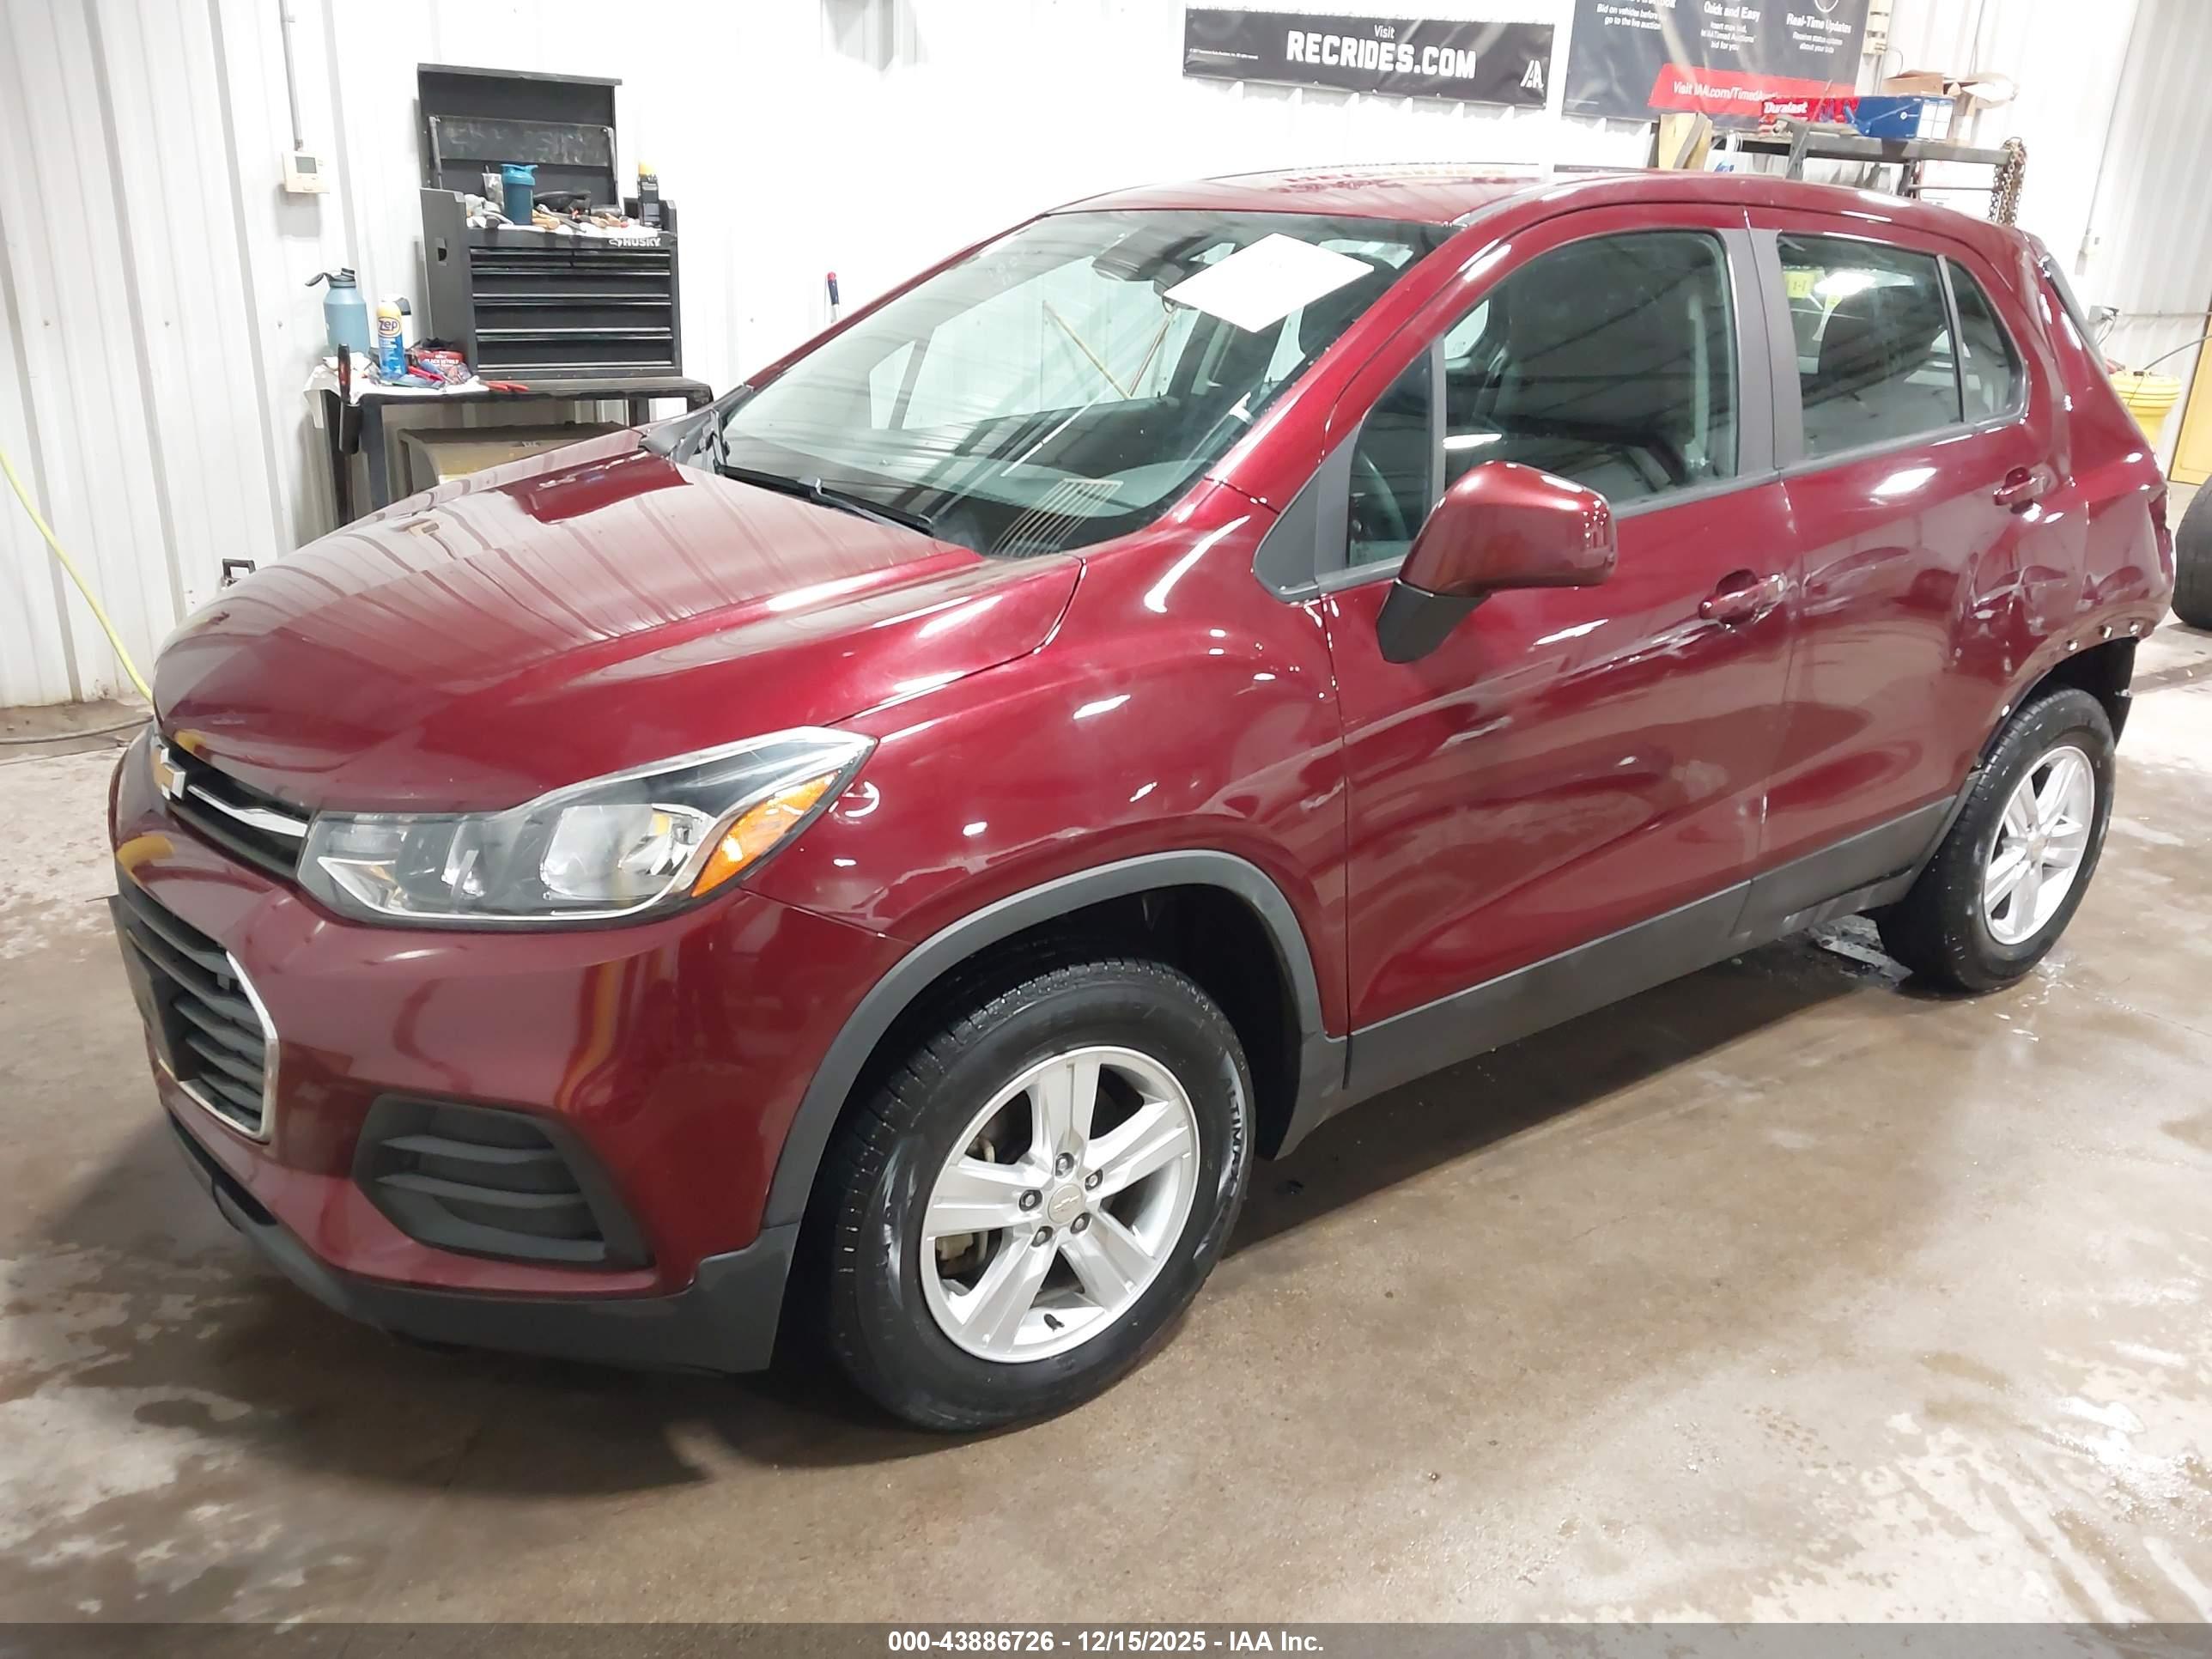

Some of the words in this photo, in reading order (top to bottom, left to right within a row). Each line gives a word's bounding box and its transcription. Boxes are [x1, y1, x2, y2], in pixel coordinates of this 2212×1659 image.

[1597, 3, 1608, 13] Bid
[1619, 7, 1639, 17] vehicles
[1640, 9, 1658, 20] before
[1704, 1, 1723, 15] Quick
[1724, 7, 1740, 17] and
[1741, 7, 1760, 22] Easy
[1605, 16, 1613, 25] go
[1622, 17, 1631, 26] the
[1632, 18, 1640, 27] live
[1786, 12, 1825, 29] Real-Time
[1826, 19, 1851, 33] Updates
[1374, 25, 1395, 39] Visit
[1286, 30, 1477, 79] RECRIDES.COM
[1674, 81, 1692, 95] Visit
[1764, 101, 1808, 114] Duralast
[623, 237, 660, 247] HUSKY
